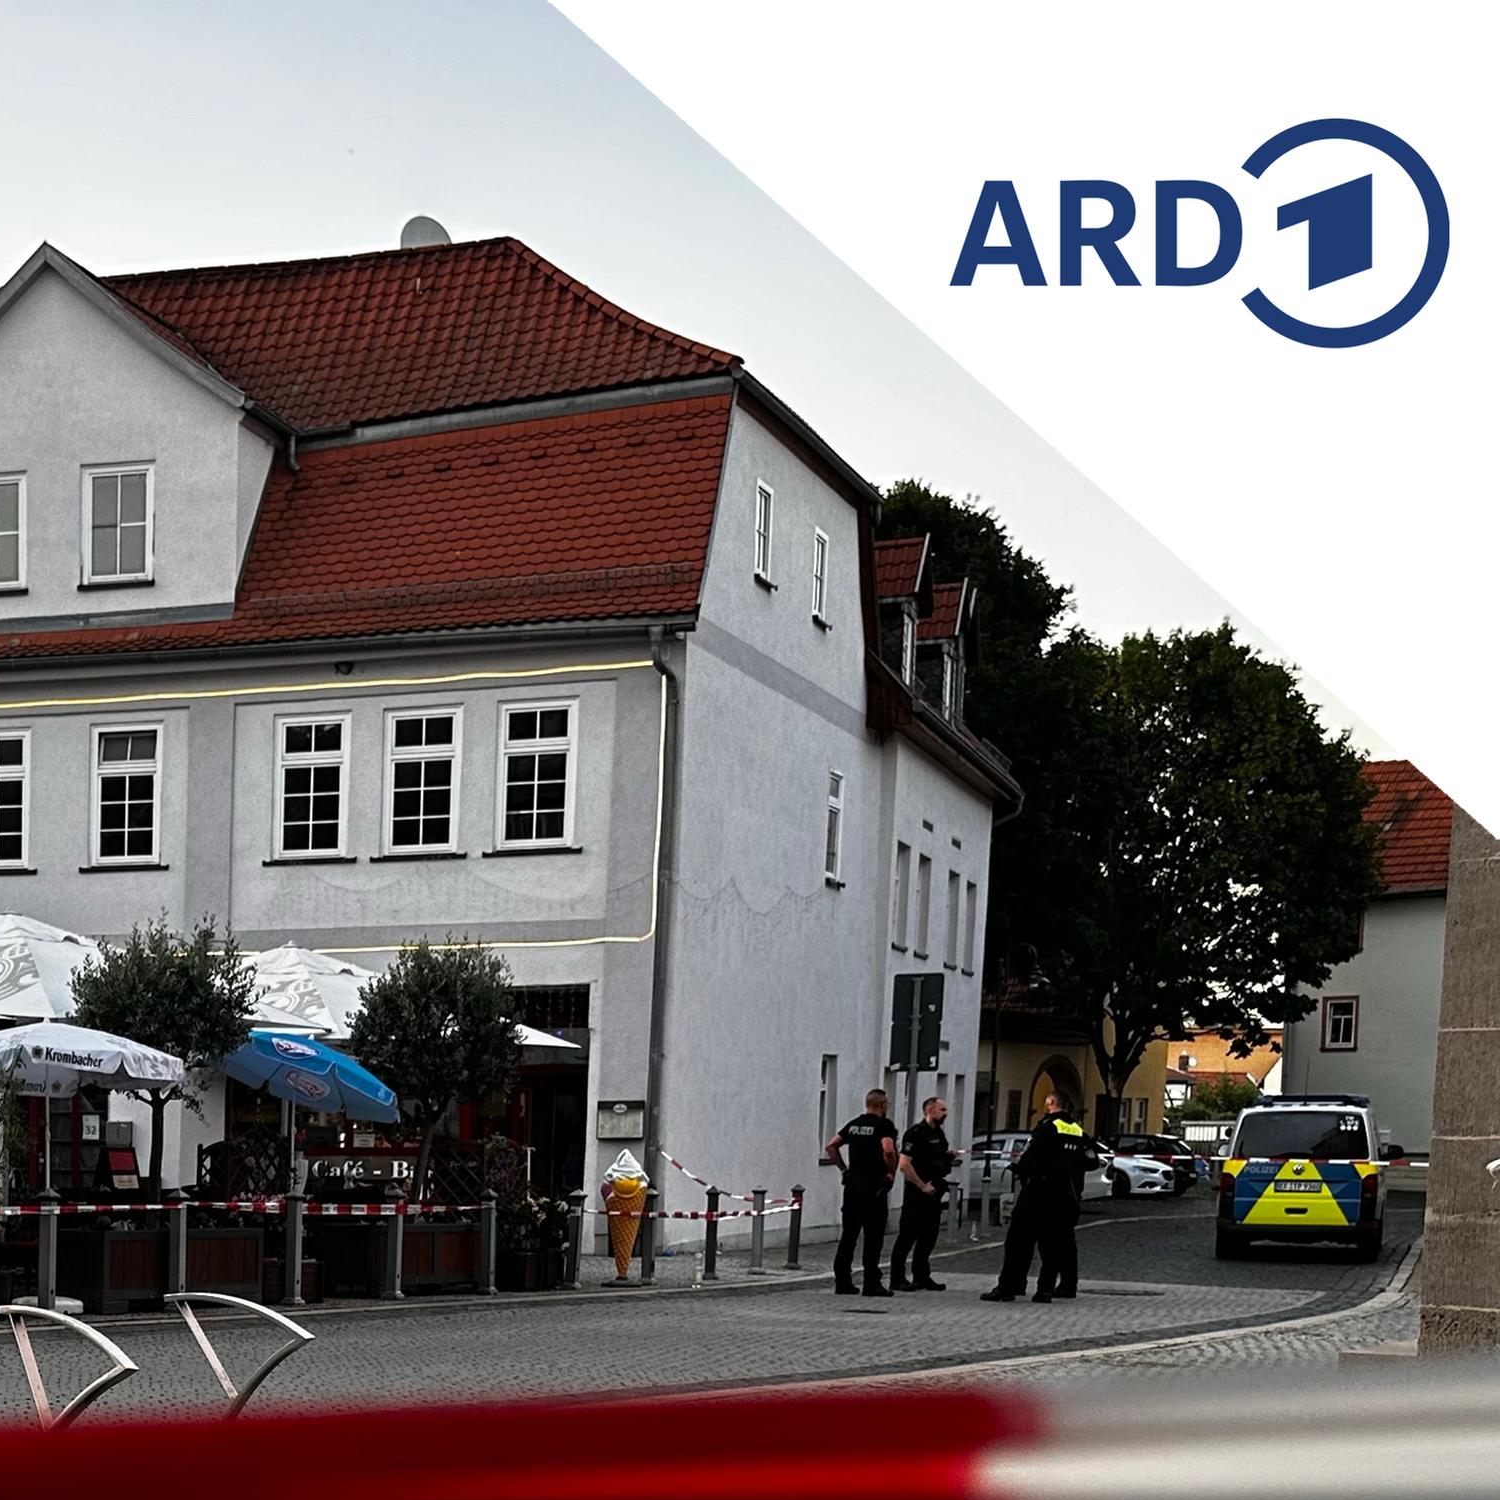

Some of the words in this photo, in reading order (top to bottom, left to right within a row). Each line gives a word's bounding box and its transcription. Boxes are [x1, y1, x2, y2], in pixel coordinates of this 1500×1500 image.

[45, 1046, 103, 1068] Krombacher
[84, 1124, 98, 1137] 32
[311, 1160, 364, 1178] Café
